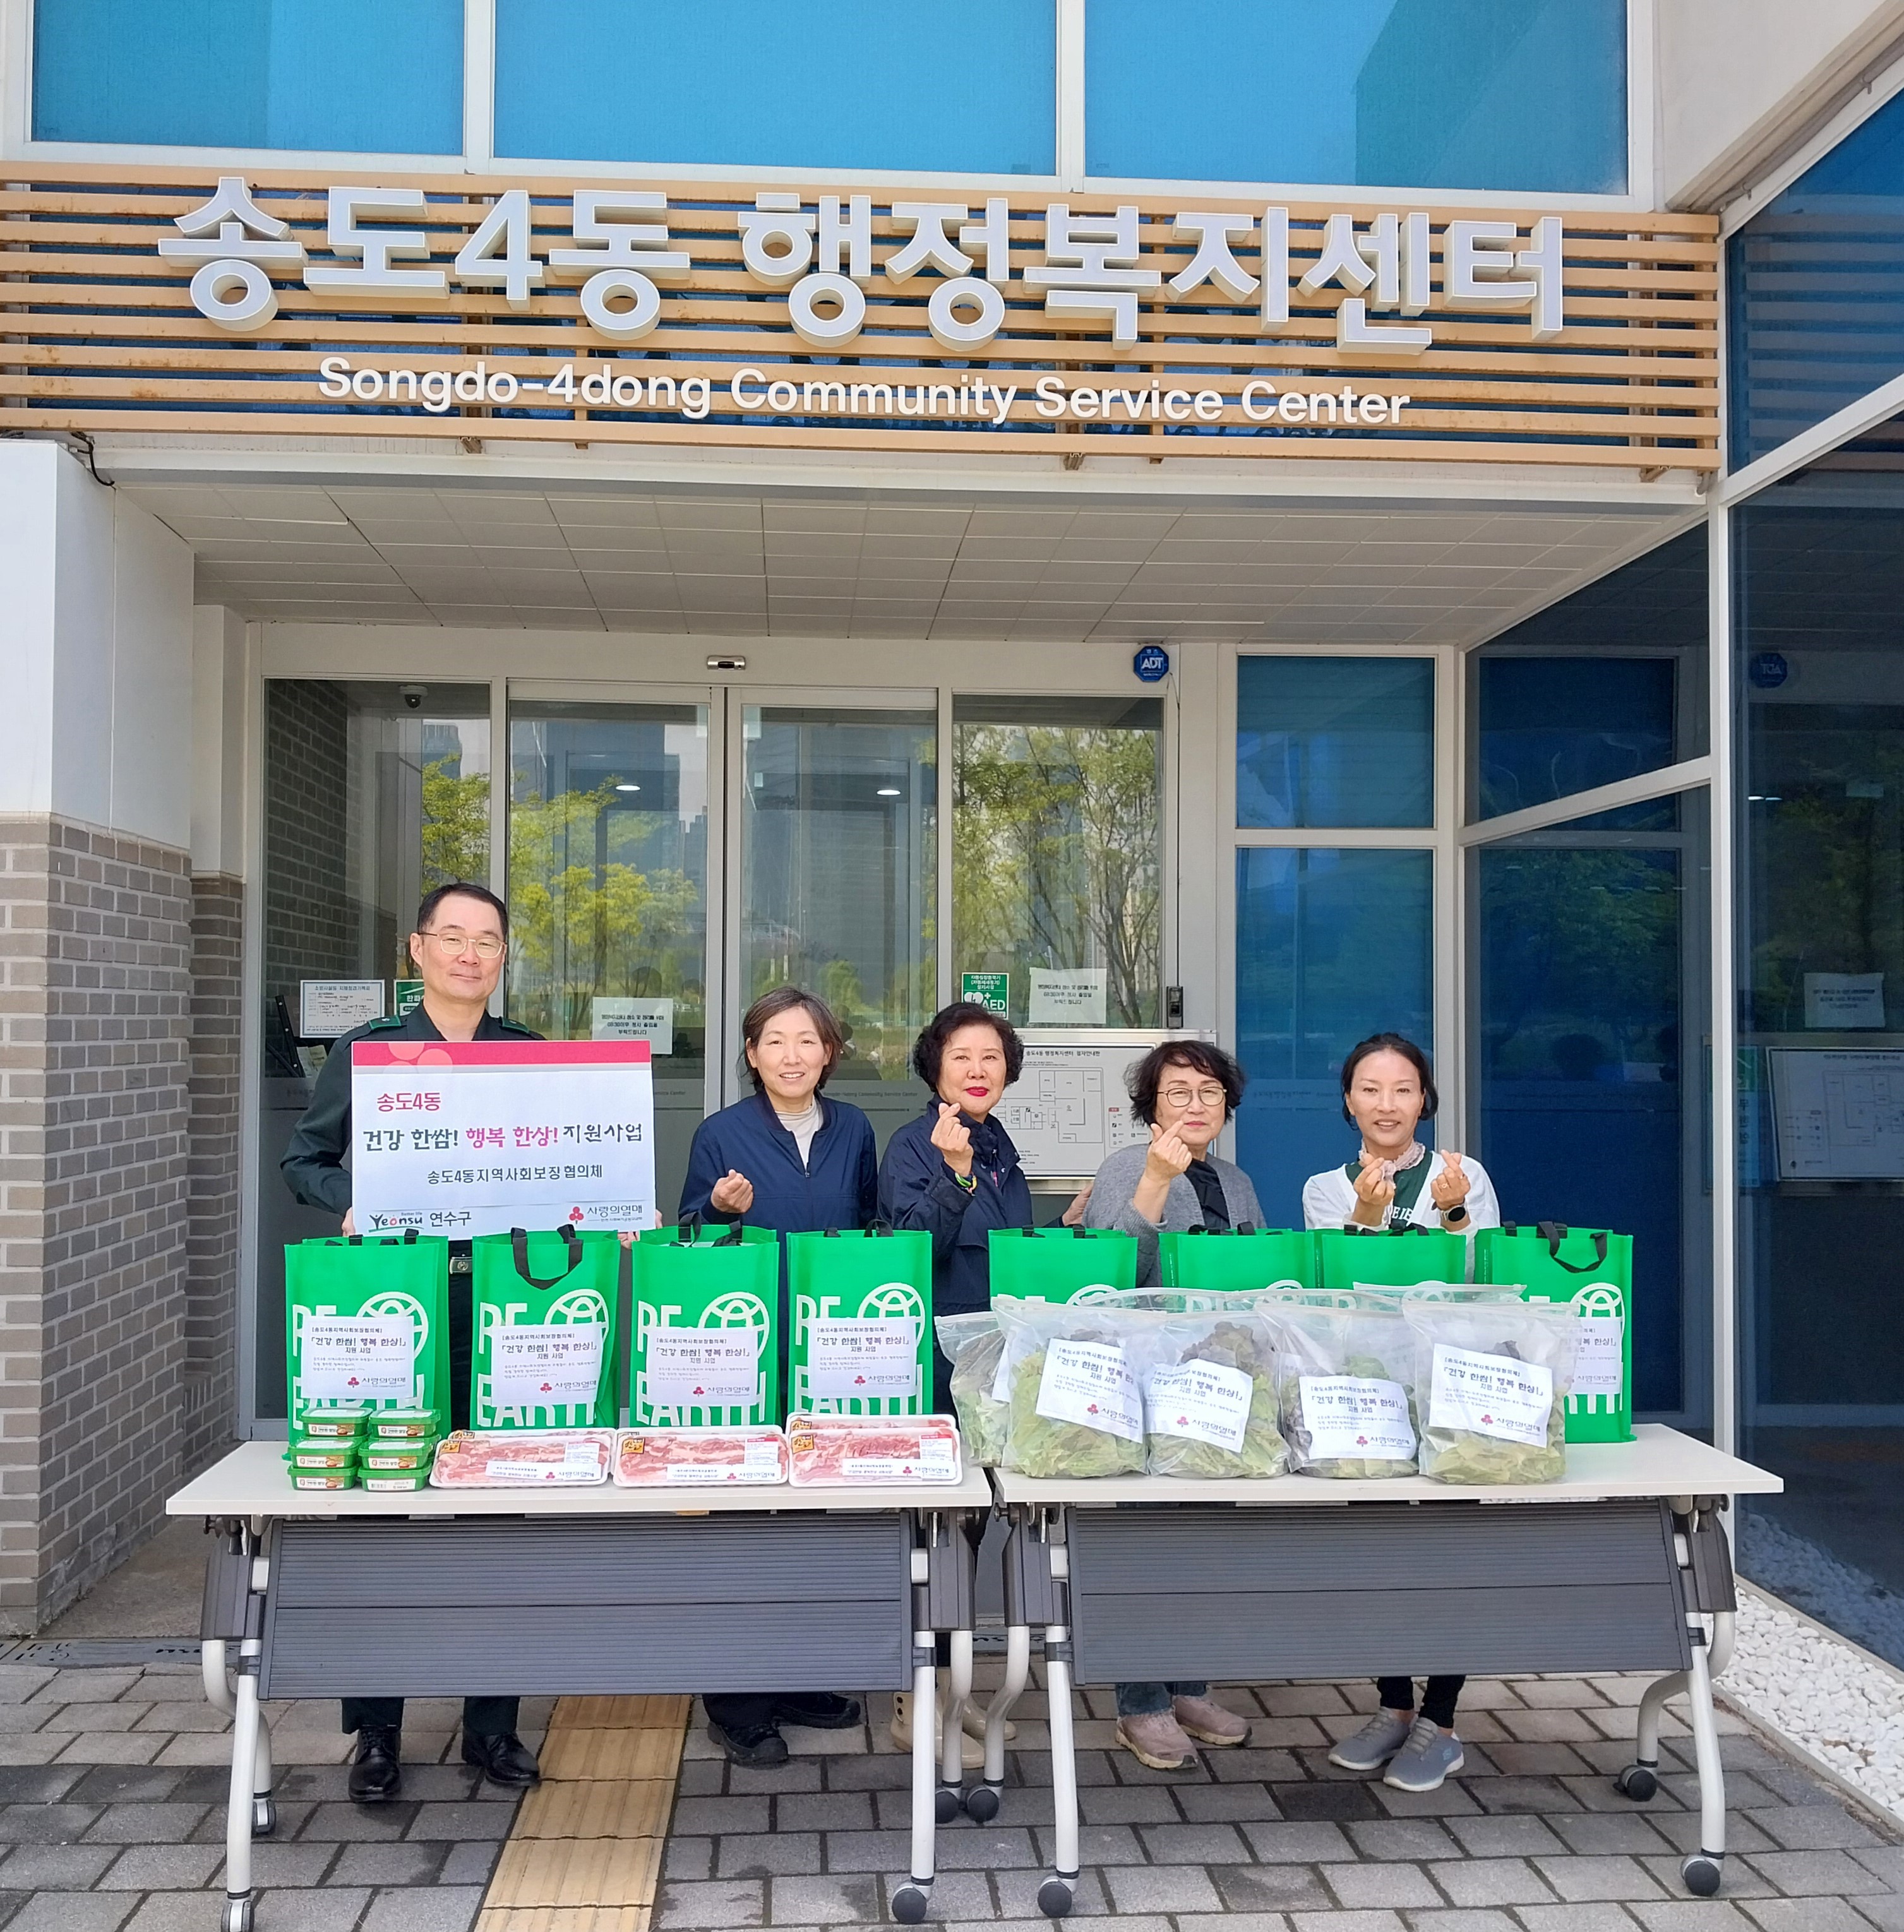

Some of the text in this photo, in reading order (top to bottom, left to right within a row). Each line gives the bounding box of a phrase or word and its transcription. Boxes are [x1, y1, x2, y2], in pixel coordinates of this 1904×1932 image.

[157, 175, 1564, 356] 송도4동 행정복지센터
[318, 356, 1410, 426] Songdo-4dong Community Service Center
[1141, 657, 1163, 669] ADT
[982, 999, 1006, 1010] AED
[376, 1092, 441, 1112] 송도4동
[362, 1123, 642, 1151] 건강 한쌈! 행복 한상! 지원사업
[428, 1164, 602, 1184] 송도4동지역사회보장협의체
[429, 1212, 472, 1228] 연수구
[587, 1205, 643, 1218] 사랑의열매
[369, 1213, 423, 1230] Yeonsu
